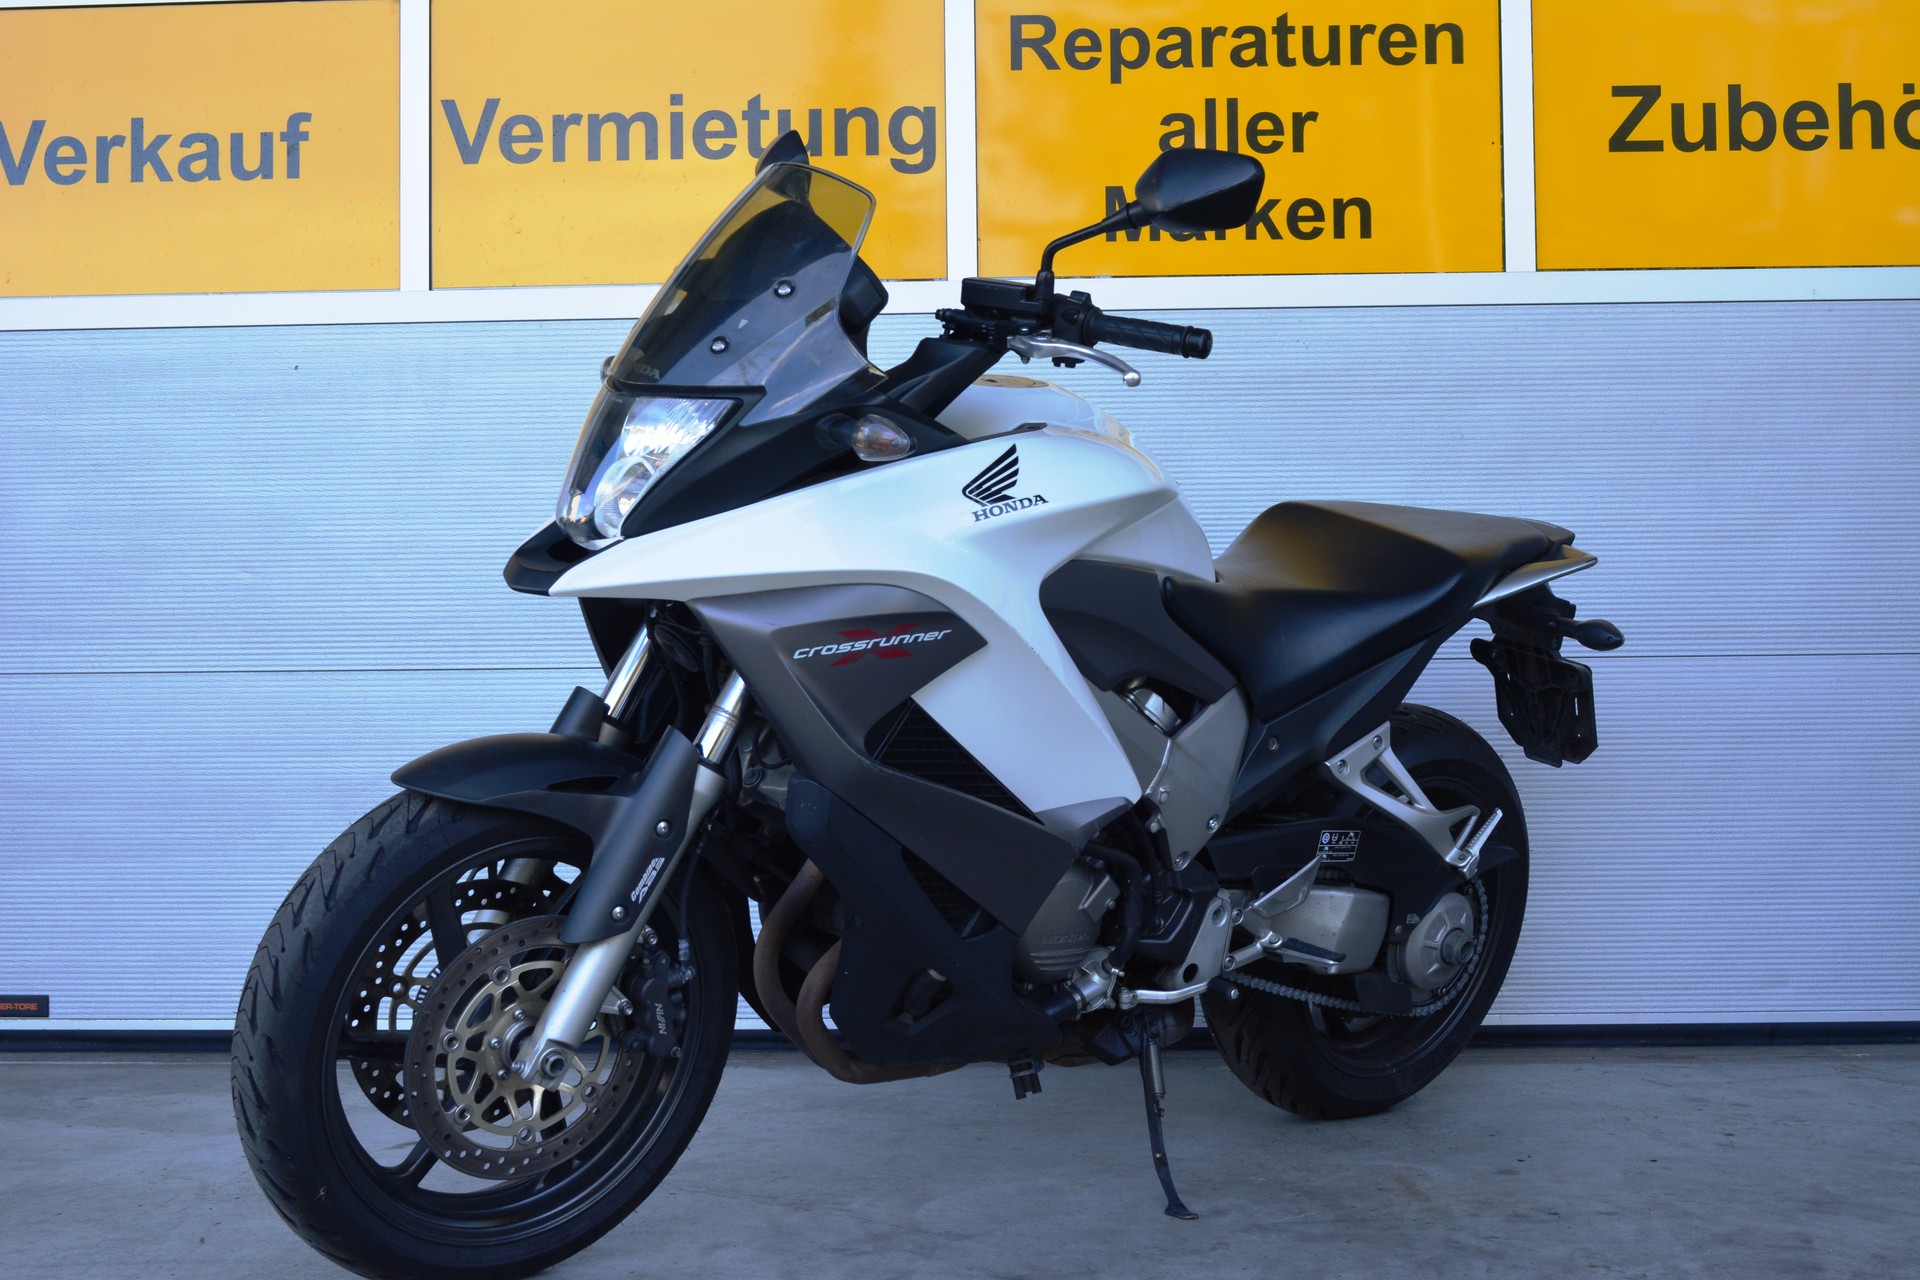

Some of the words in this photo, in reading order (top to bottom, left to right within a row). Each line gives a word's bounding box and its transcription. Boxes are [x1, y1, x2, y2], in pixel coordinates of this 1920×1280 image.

[1009, 11, 1465, 85] Reparaturen
[0, 112, 312, 186] Verkauf
[440, 93, 938, 175] Vermietung
[1158, 97, 1320, 155] aller
[971, 494, 1050, 522] HONDA
[793, 629, 952, 659] crossrunner
